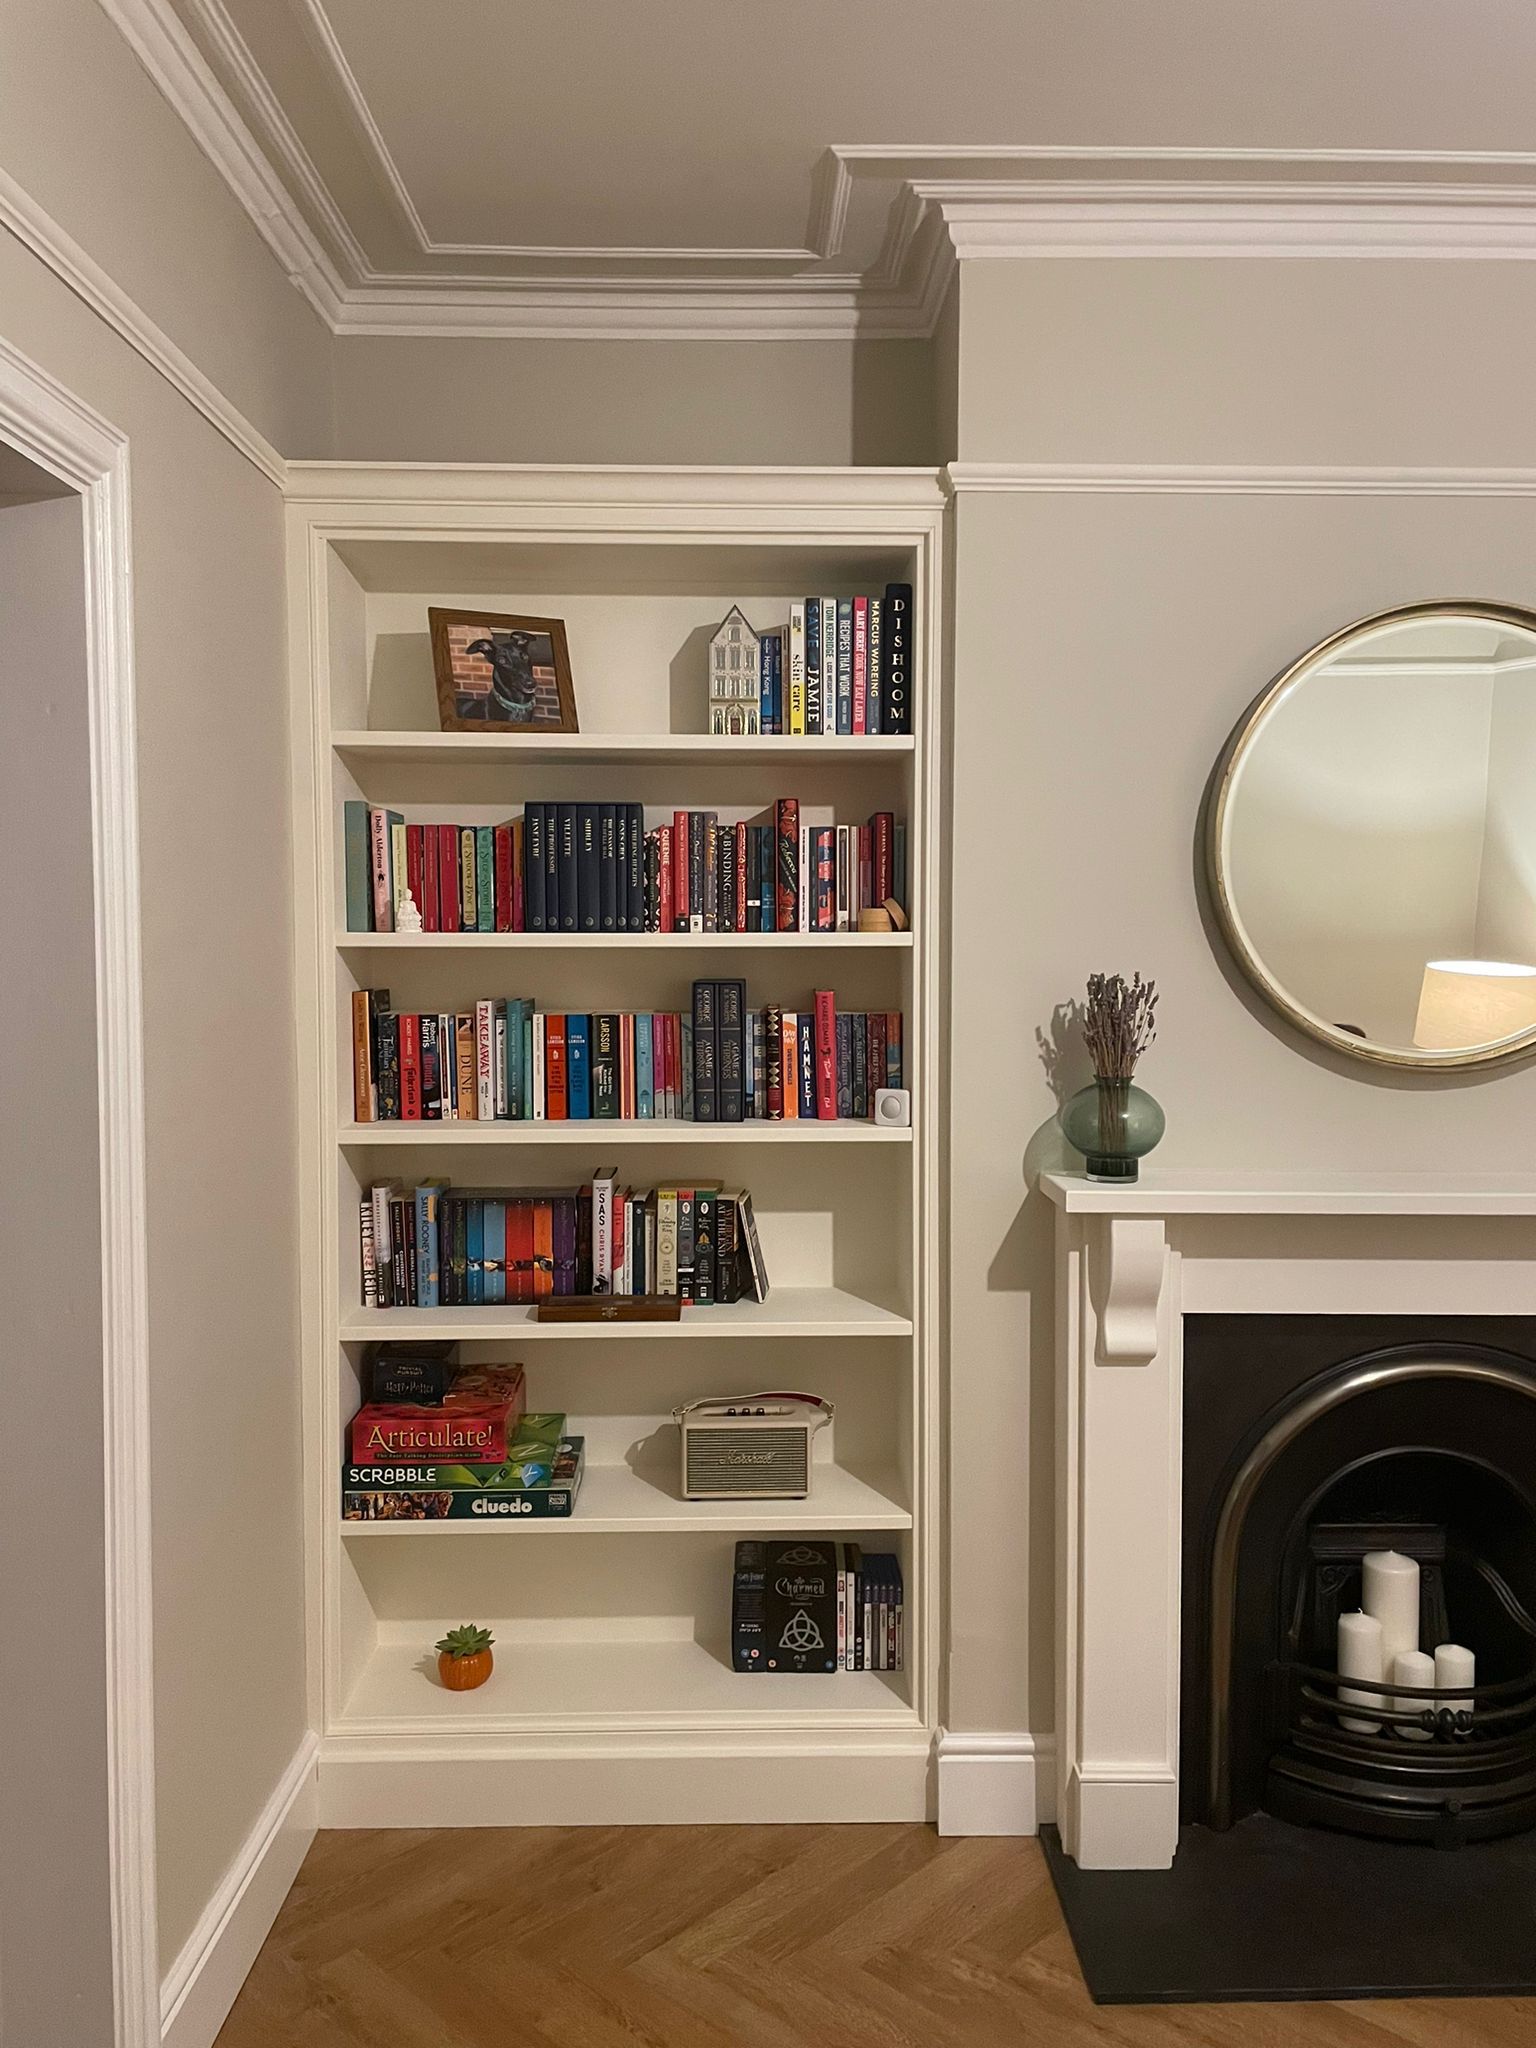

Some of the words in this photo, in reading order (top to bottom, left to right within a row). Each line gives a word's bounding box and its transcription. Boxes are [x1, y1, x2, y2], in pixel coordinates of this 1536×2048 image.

[808, 606, 819, 648] SAVE
[826, 606, 835, 622] TOM
[871, 601, 880, 645] MARCUS
[826, 623, 835, 658] KERRIDGE
[839, 620, 851, 651] RECIPES
[763, 656, 772, 674] Hong
[793, 654, 803, 682] skin
[839, 653, 851, 672] THAT
[871, 648, 880, 698] WAREING
[888, 599, 906, 719] DISHOOM
[763, 676, 772, 696] Kong
[793, 685, 802, 712] care
[807, 667, 819, 723] JAMIE
[839, 675, 851, 697] WORK
[375, 815, 384, 834] Dolly
[564, 818, 572, 858] VILLETTE
[376, 837, 385, 869] Alderton
[662, 829, 670, 865] QUEENIE
[779, 839, 797, 874] Rebecca
[723, 840, 732, 892] BINDING
[703, 990, 711, 1022] GEORGE
[730, 990, 738, 1022] GEORGE
[421, 1018, 430, 1048] Harris
[429, 1022, 437, 1045] Robert
[479, 1005, 490, 1079] TAKEAWAY
[600, 1018, 610, 1053] LARSSON
[822, 1023, 830, 1045] OSMAN
[695, 1039, 706, 1079] THRONES
[704, 1046, 714, 1069] GAME
[721, 1039, 732, 1079] THRONES
[731, 1046, 740, 1069] GAME
[802, 1026, 813, 1107] HAMNET
[461, 1054, 473, 1096] DUNE
[420, 1196, 429, 1217] SALLY
[598, 1193, 606, 1226] SAS
[718, 1203, 726, 1217] AT
[361, 1206, 374, 1240] KILEY
[421, 1220, 430, 1254] ROONEY
[718, 1218, 726, 1239] THE
[718, 1239, 726, 1257] END
[725, 1228, 734, 1252] BEGIN
[364, 1269, 377, 1296] REID
[409, 1381, 434, 1395] Potter
[366, 1424, 493, 1455] Articulate!
[350, 1468, 437, 1485] SCRABBLE
[471, 1497, 533, 1514] Cluedo
[775, 1577, 829, 1600] Charmed
